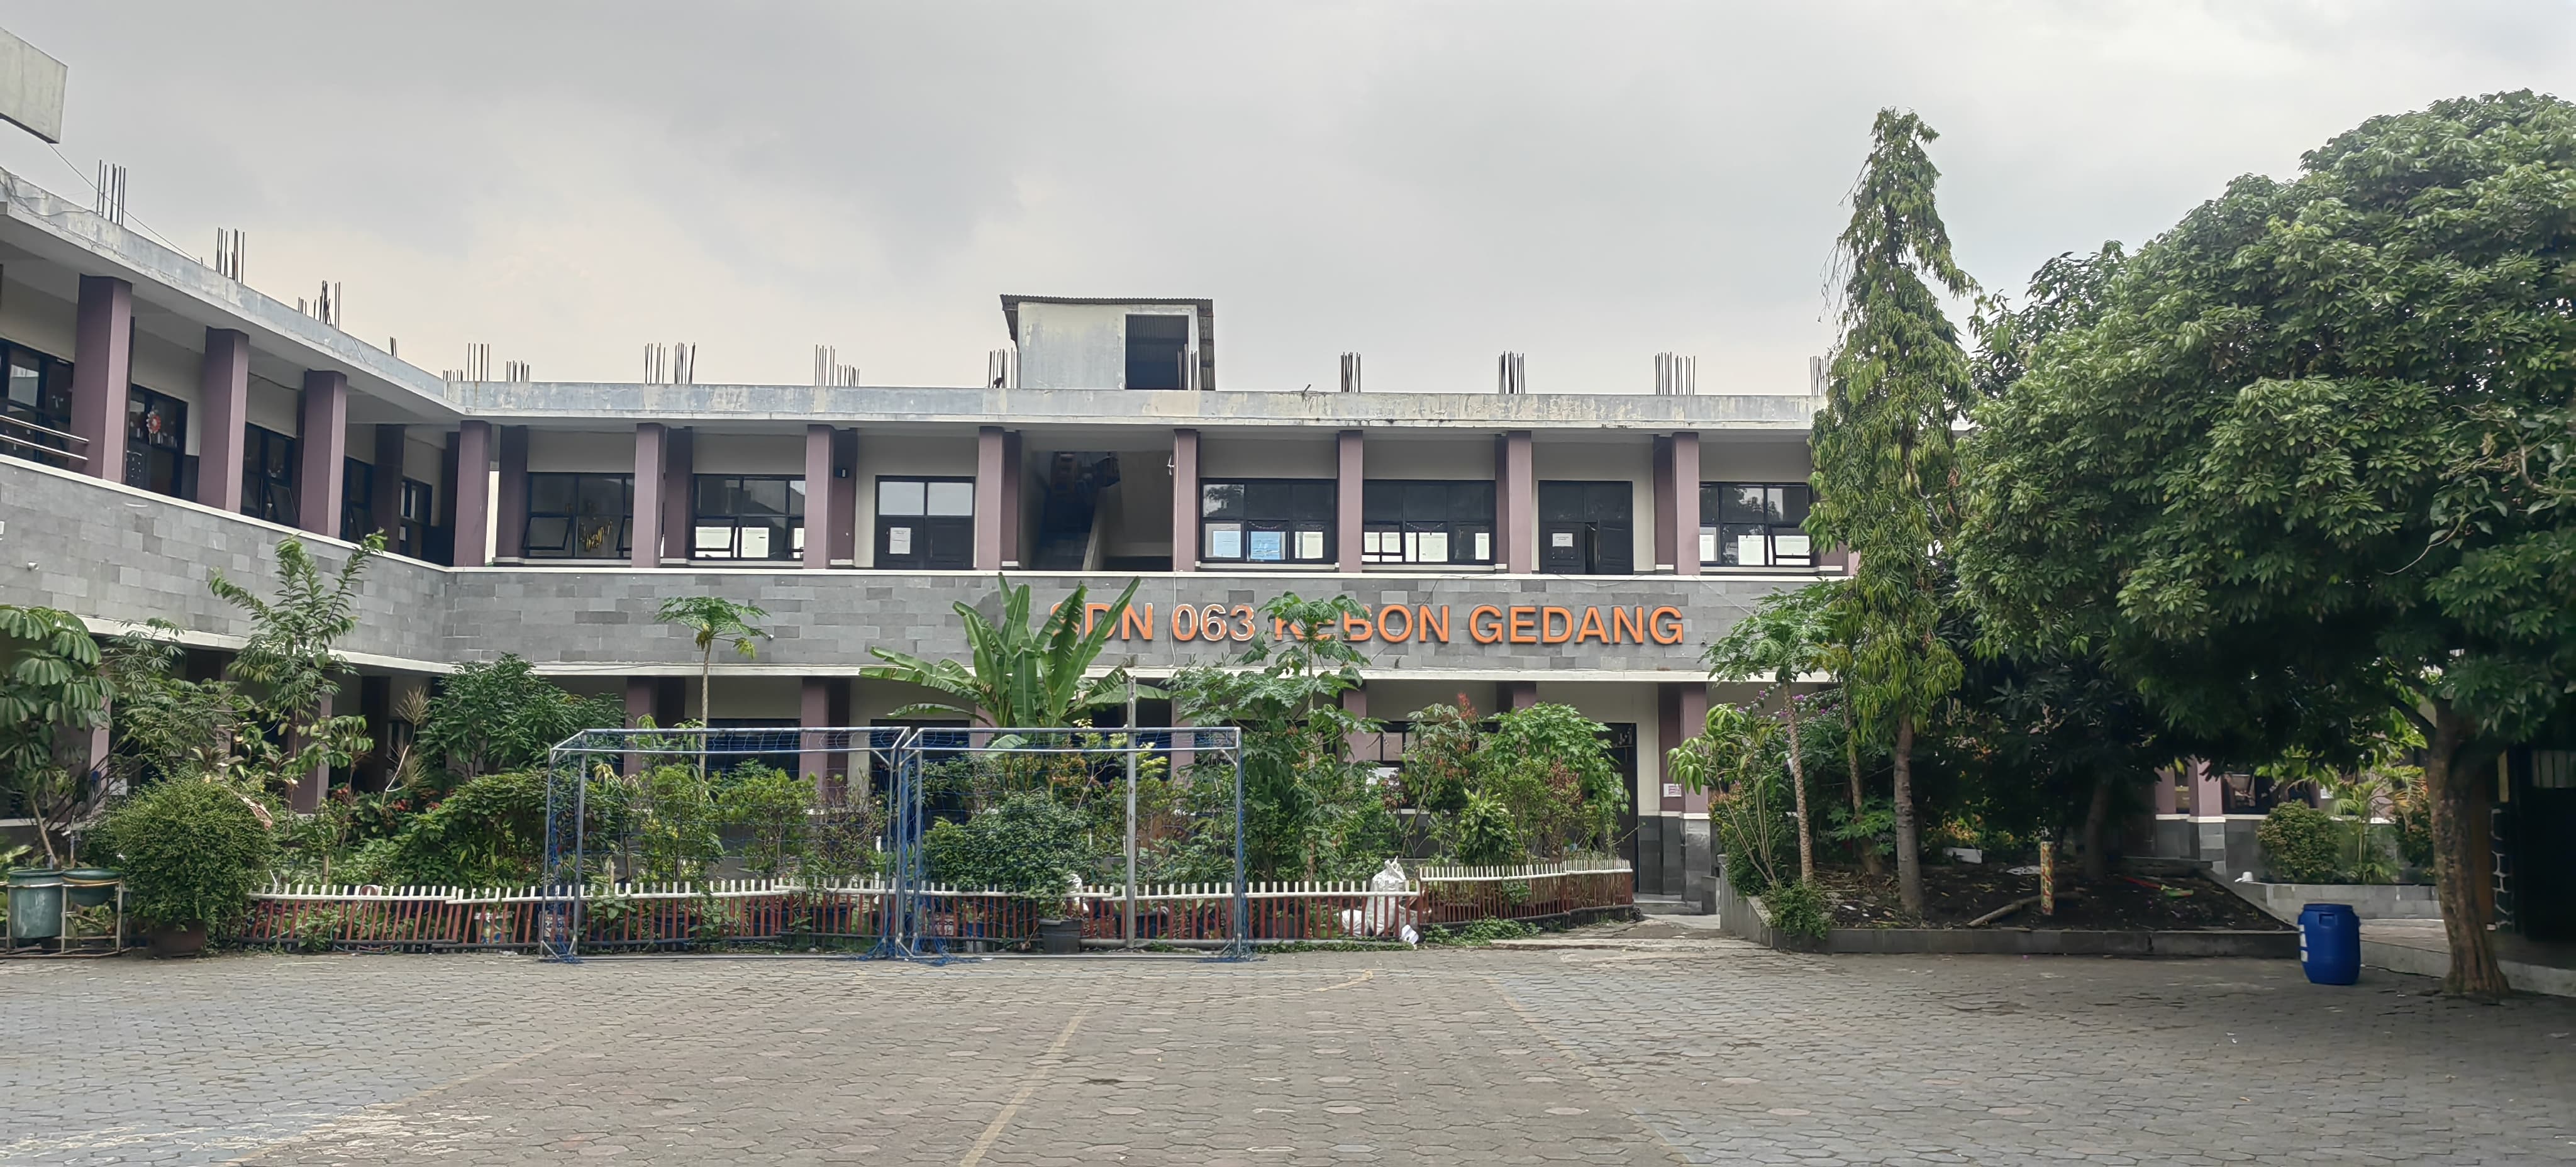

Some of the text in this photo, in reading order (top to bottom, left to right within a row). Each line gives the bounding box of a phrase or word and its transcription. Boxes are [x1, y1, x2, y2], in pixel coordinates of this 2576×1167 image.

[1050, 601, 1153, 640] DN
[1172, 604, 1255, 641] 063
[1469, 605, 1684, 644] GEDANG
